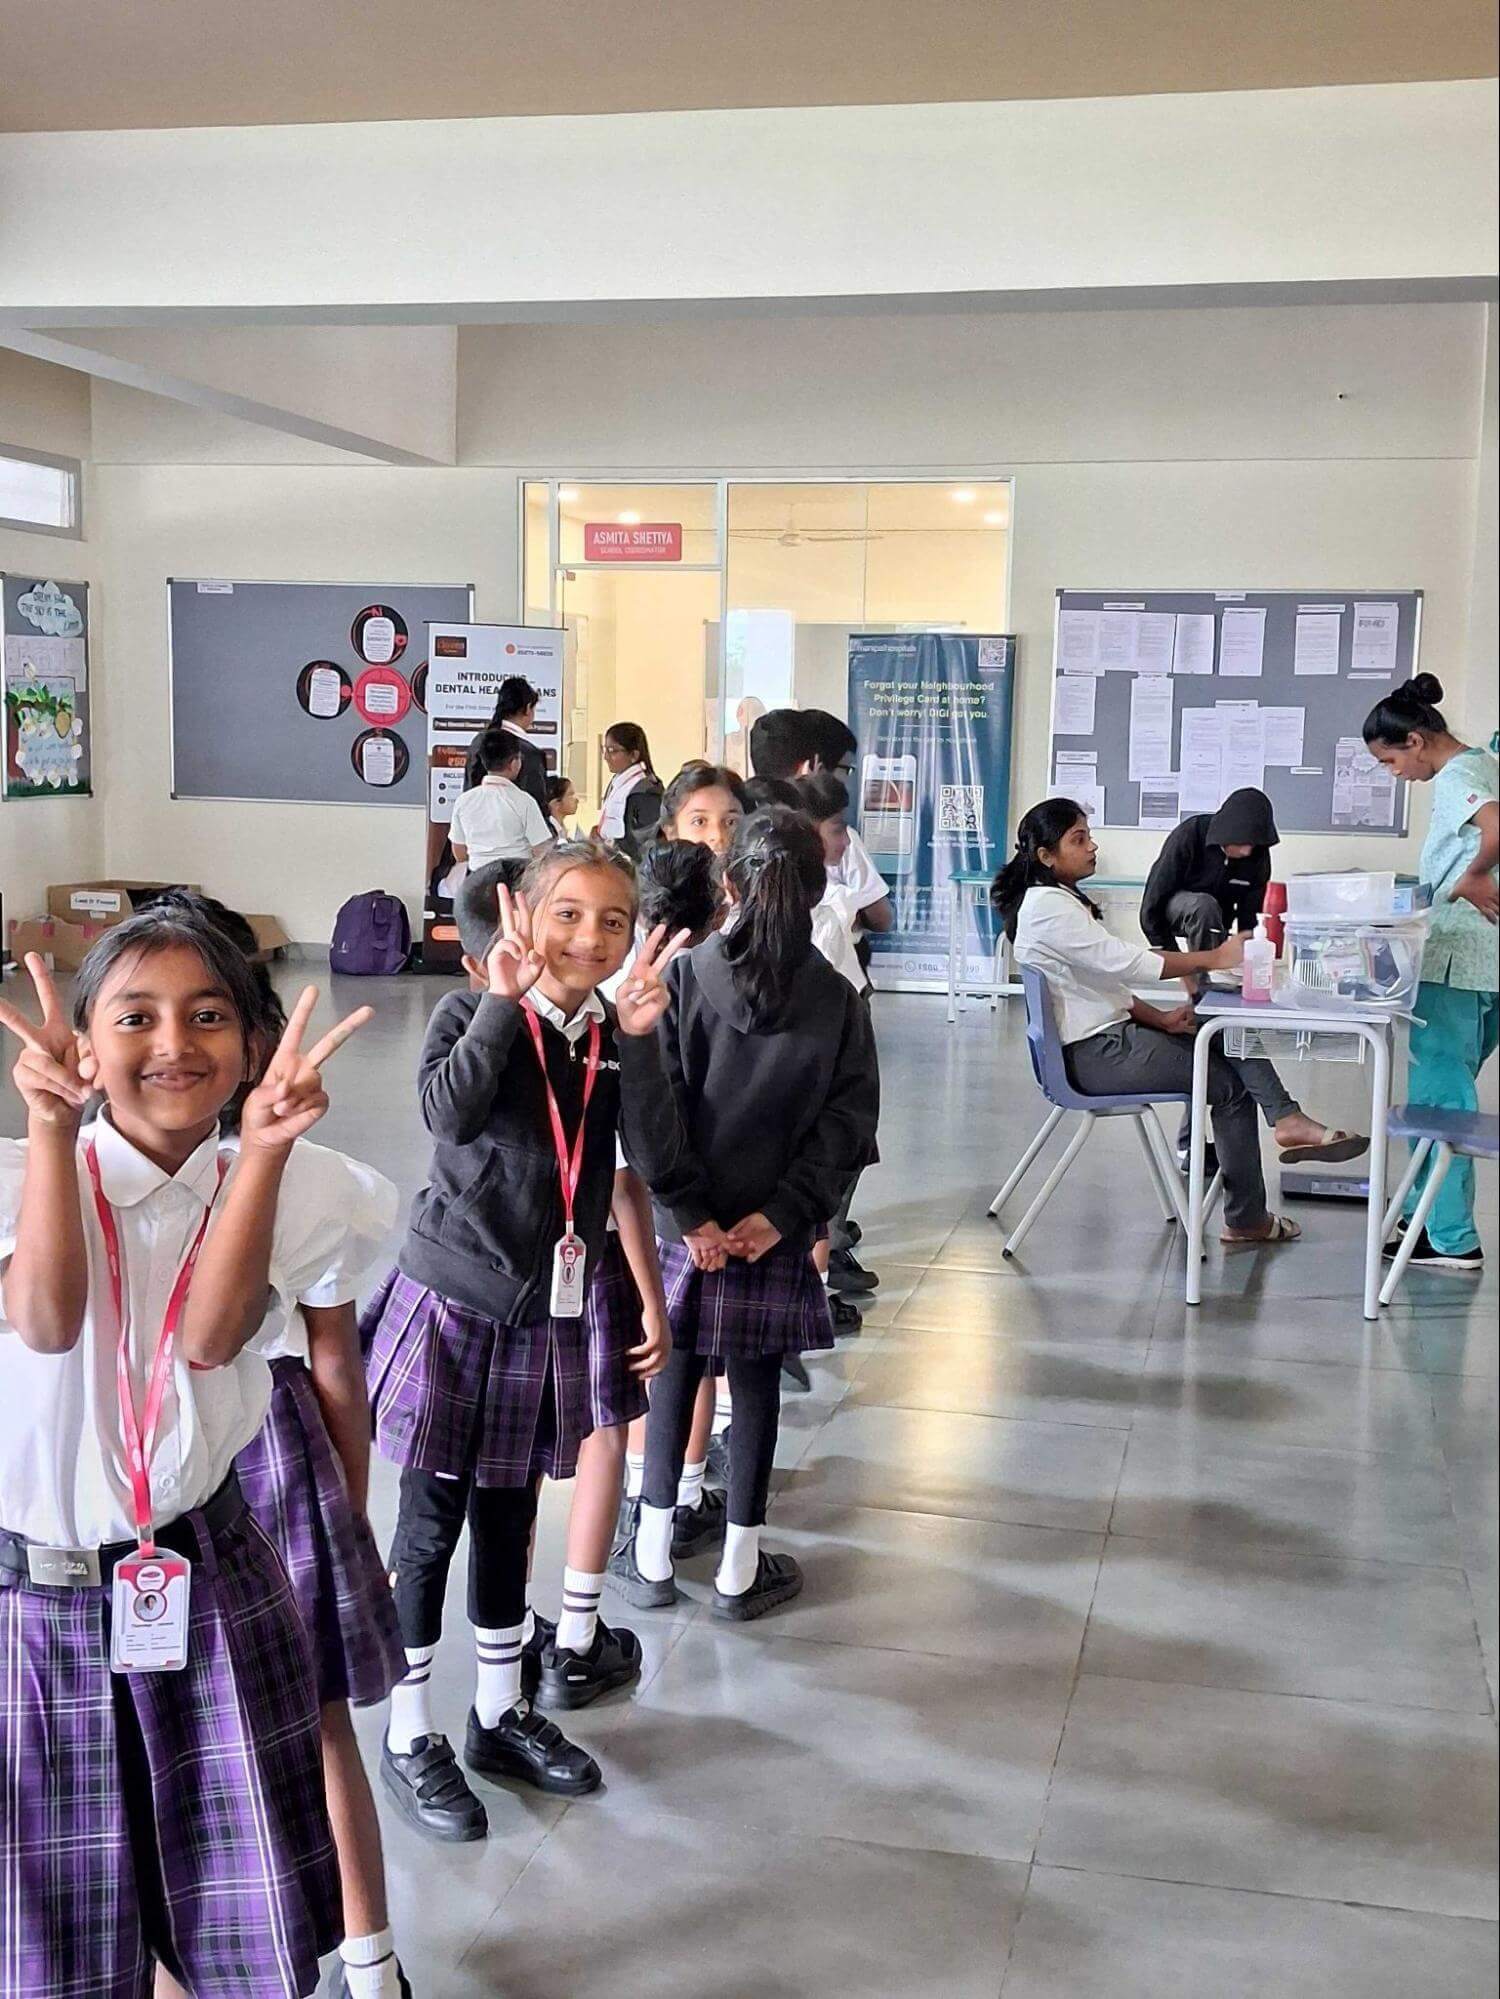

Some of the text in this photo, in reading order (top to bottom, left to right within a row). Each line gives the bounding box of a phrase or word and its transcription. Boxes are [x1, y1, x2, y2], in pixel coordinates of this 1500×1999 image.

[593, 531, 630, 544] ASMITA
[435, 684, 476, 694] DENTAL
[864, 680, 994, 693] Forgot your Neighbourhood
[873, 694, 986, 705] Privilege Card at home?
